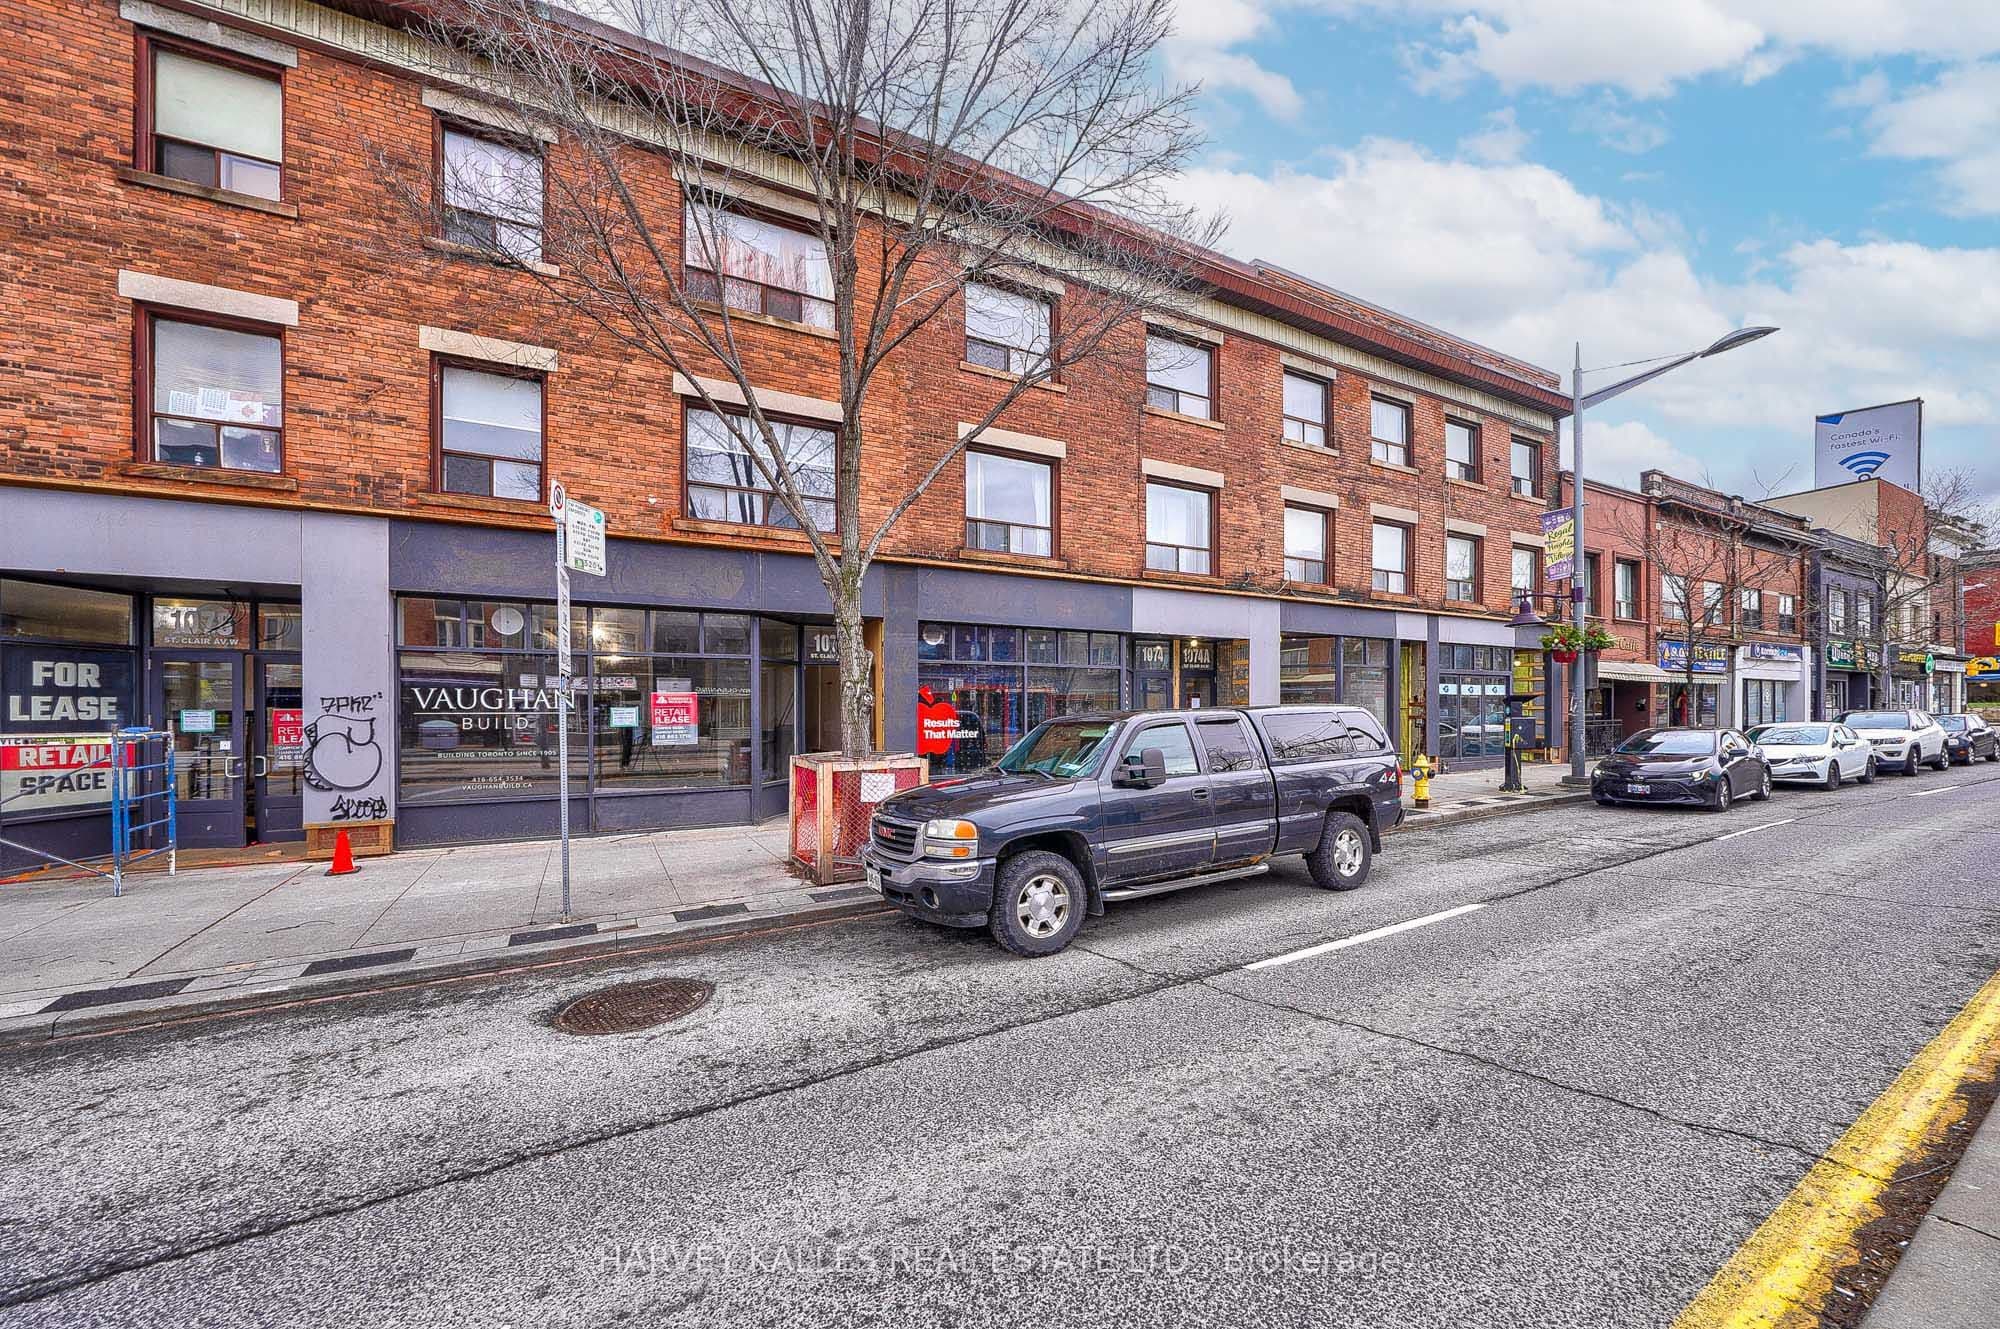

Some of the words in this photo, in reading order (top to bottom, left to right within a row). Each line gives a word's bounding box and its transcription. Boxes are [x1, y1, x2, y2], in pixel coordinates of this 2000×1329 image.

[1830, 428, 1880, 441] Canada's
[1830, 439, 1867, 450] fastest
[1547, 522, 1573, 541] Regal
[181, 637, 210, 645] CLAIR
[1142, 647, 1163, 662] 1074
[1183, 648, 1210, 664] 1074A
[32, 661, 101, 688] FOR
[411, 687, 576, 711] VAUGHAN
[10, 696, 118, 721] LEASE
[655, 708, 688, 716] RETAIL
[462, 717, 529, 730] BUILD
[923, 718, 960, 727] Results
[924, 730, 946, 739] That
[947, 729, 978, 739] Matter
[19, 745, 111, 767] RETAIL
[20, 772, 107, 796] SPACE
[462, 783, 533, 791] VAUGHANBUILD.CA
